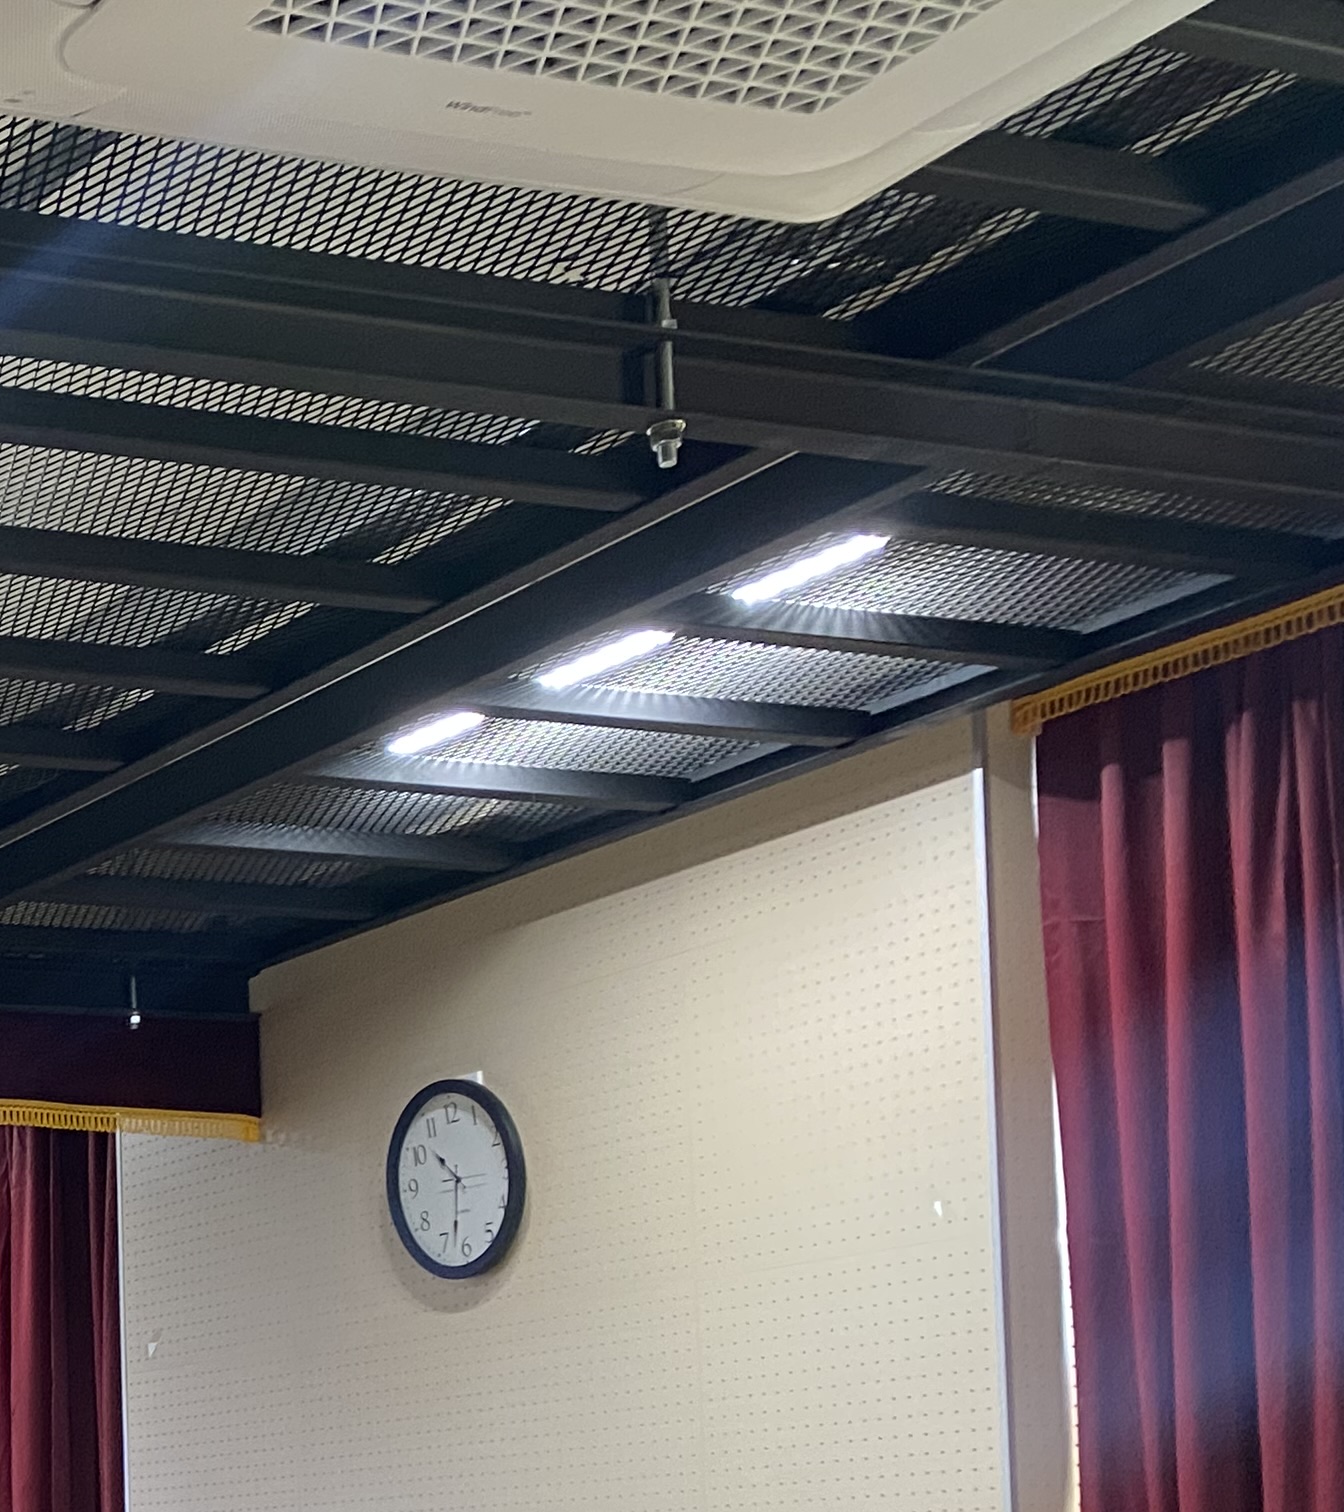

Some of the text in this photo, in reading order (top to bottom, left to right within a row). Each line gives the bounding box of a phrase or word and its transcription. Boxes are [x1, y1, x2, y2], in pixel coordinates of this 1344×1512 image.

[443, 1102, 460, 1124] 12
[471, 1105, 477, 1126] 1
[426, 1117, 437, 1138] 11
[491, 1130, 501, 1147] 2
[413, 1144, 427, 1167] 10
[408, 1178, 418, 1200] 9
[420, 1210, 430, 1231] 8
[439, 1232, 449, 1253] 7
[485, 1222, 494, 1243] 5
[462, 1236, 472, 1257] 6
